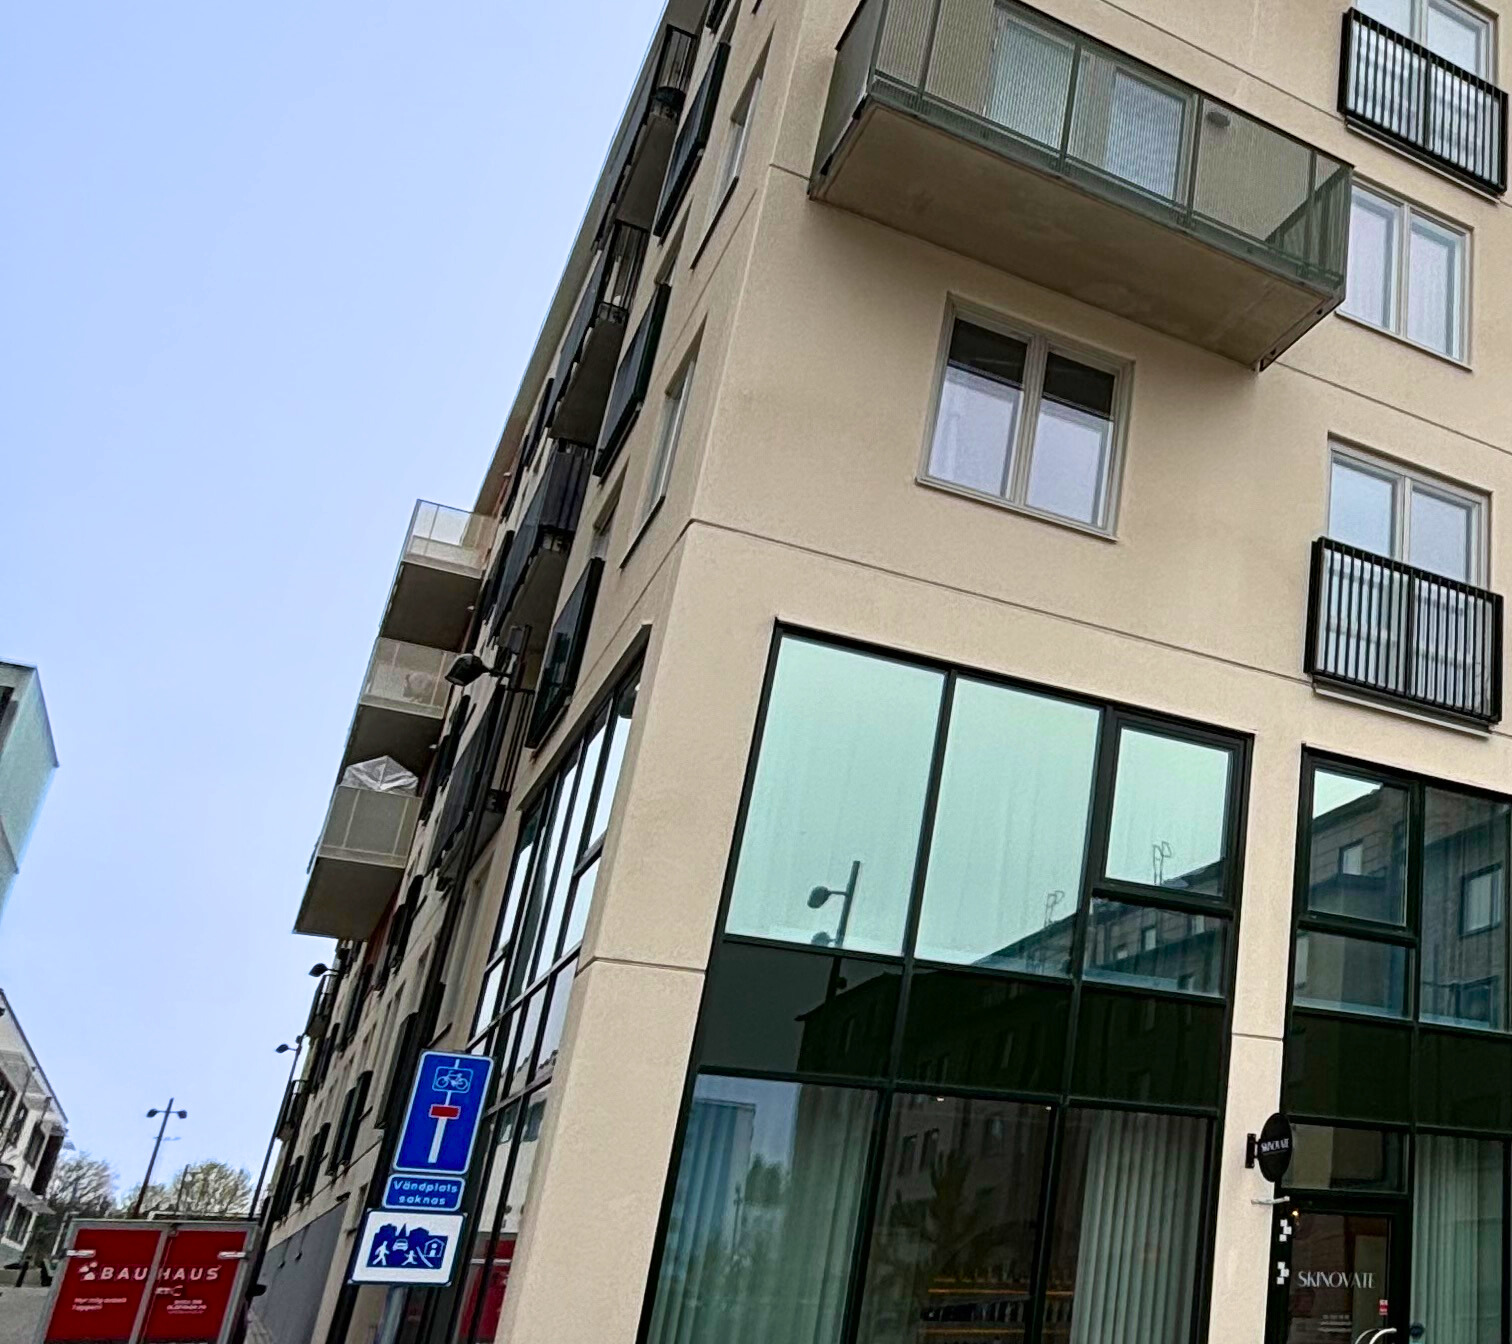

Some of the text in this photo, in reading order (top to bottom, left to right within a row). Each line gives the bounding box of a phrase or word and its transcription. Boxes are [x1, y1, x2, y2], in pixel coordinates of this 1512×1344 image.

[394, 1180, 458, 1193] Vändplats
[399, 1195, 446, 1205] saknas
[100, 1266, 220, 1281] BAUHAUS
[1298, 1270, 1376, 1288] SKINOVATE
